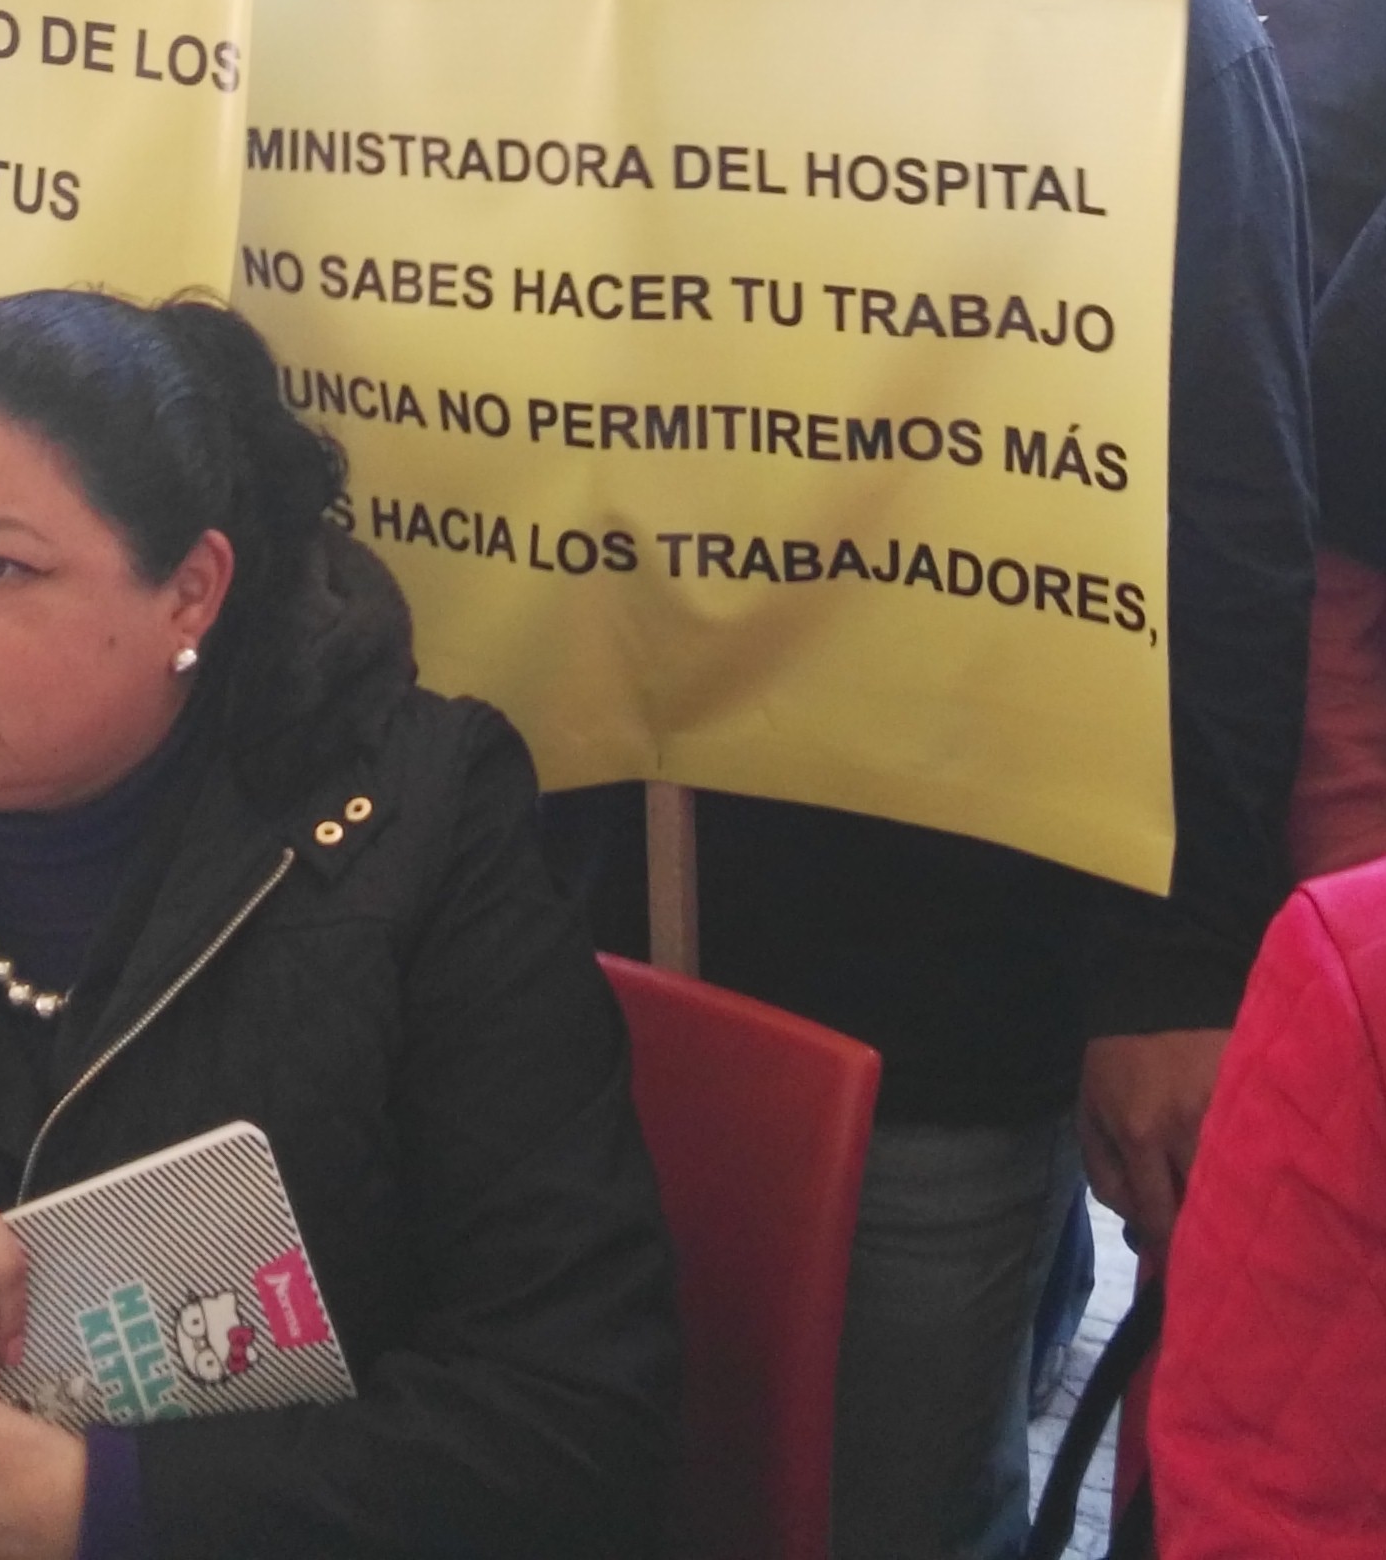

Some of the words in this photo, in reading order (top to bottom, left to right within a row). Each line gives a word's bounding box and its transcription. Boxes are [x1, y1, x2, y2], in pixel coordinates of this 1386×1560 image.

[41, 17, 116, 74] DE
[135, 29, 242, 94] LOS
[672, 144, 788, 196] DEL
[805, 152, 1107, 217] HOSPITAL
[242, 246, 304, 296] NO
[319, 254, 495, 311] SABES
[512, 268, 711, 324] HACER
[732, 276, 804, 327] TU
[823, 284, 1115, 354] TRABAJO
[438, 389, 510, 440] NO
[528, 397, 983, 466] PERMITIREMOS
[1004, 424, 1129, 492] MÁS
[372, 497, 516, 562] HACIA
[528, 525, 638, 574] LOS
[656, 531, 1160, 648] TRABAJADORES,
